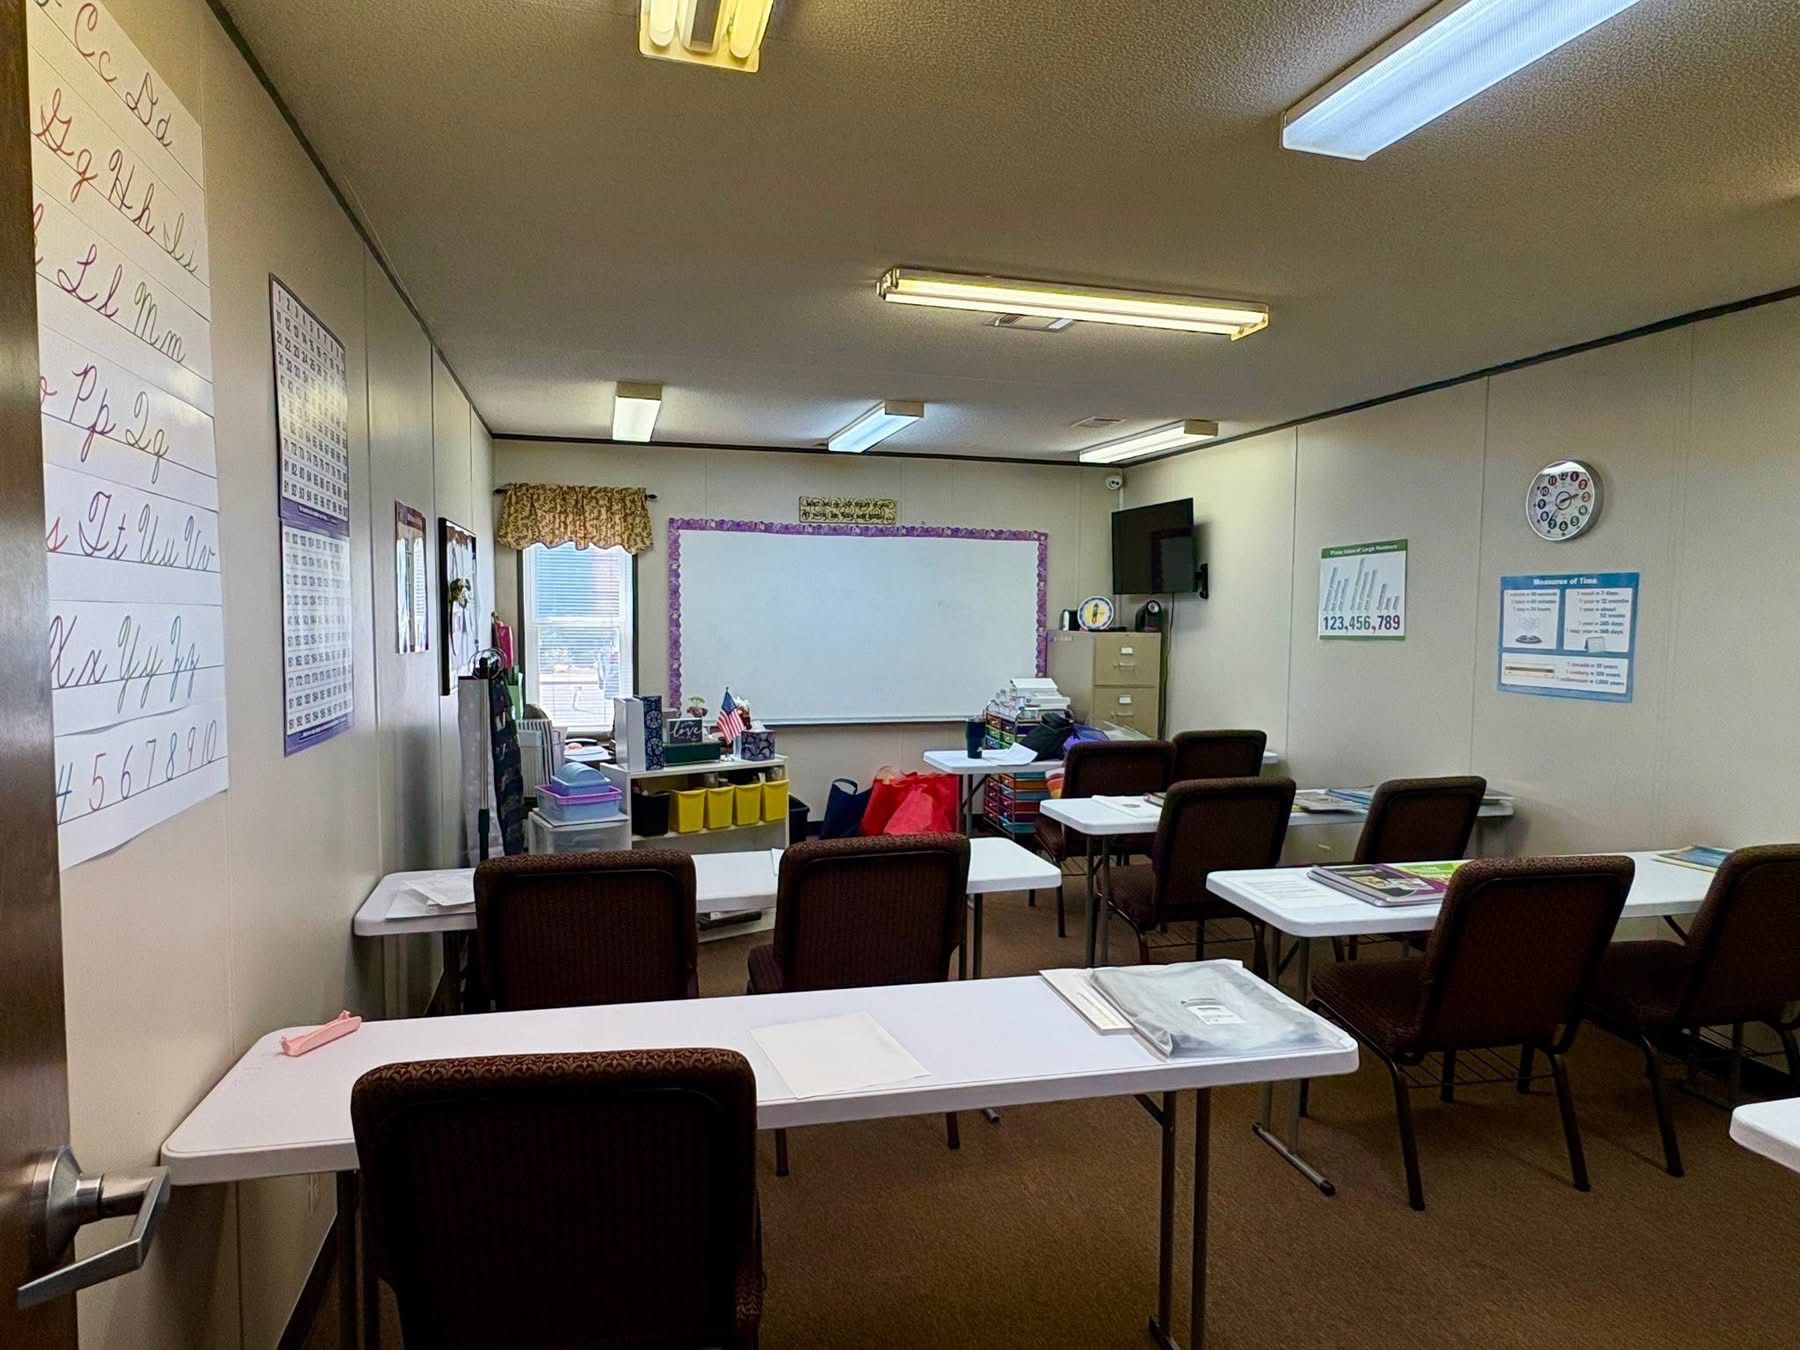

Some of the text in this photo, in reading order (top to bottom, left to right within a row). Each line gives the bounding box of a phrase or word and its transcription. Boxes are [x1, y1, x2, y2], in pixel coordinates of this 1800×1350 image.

[1323, 615, 1400, 632] 123,456,789
[670, 721, 702, 737] love
[56, 720, 217, 825] 4 5 6 7 8 9 10
